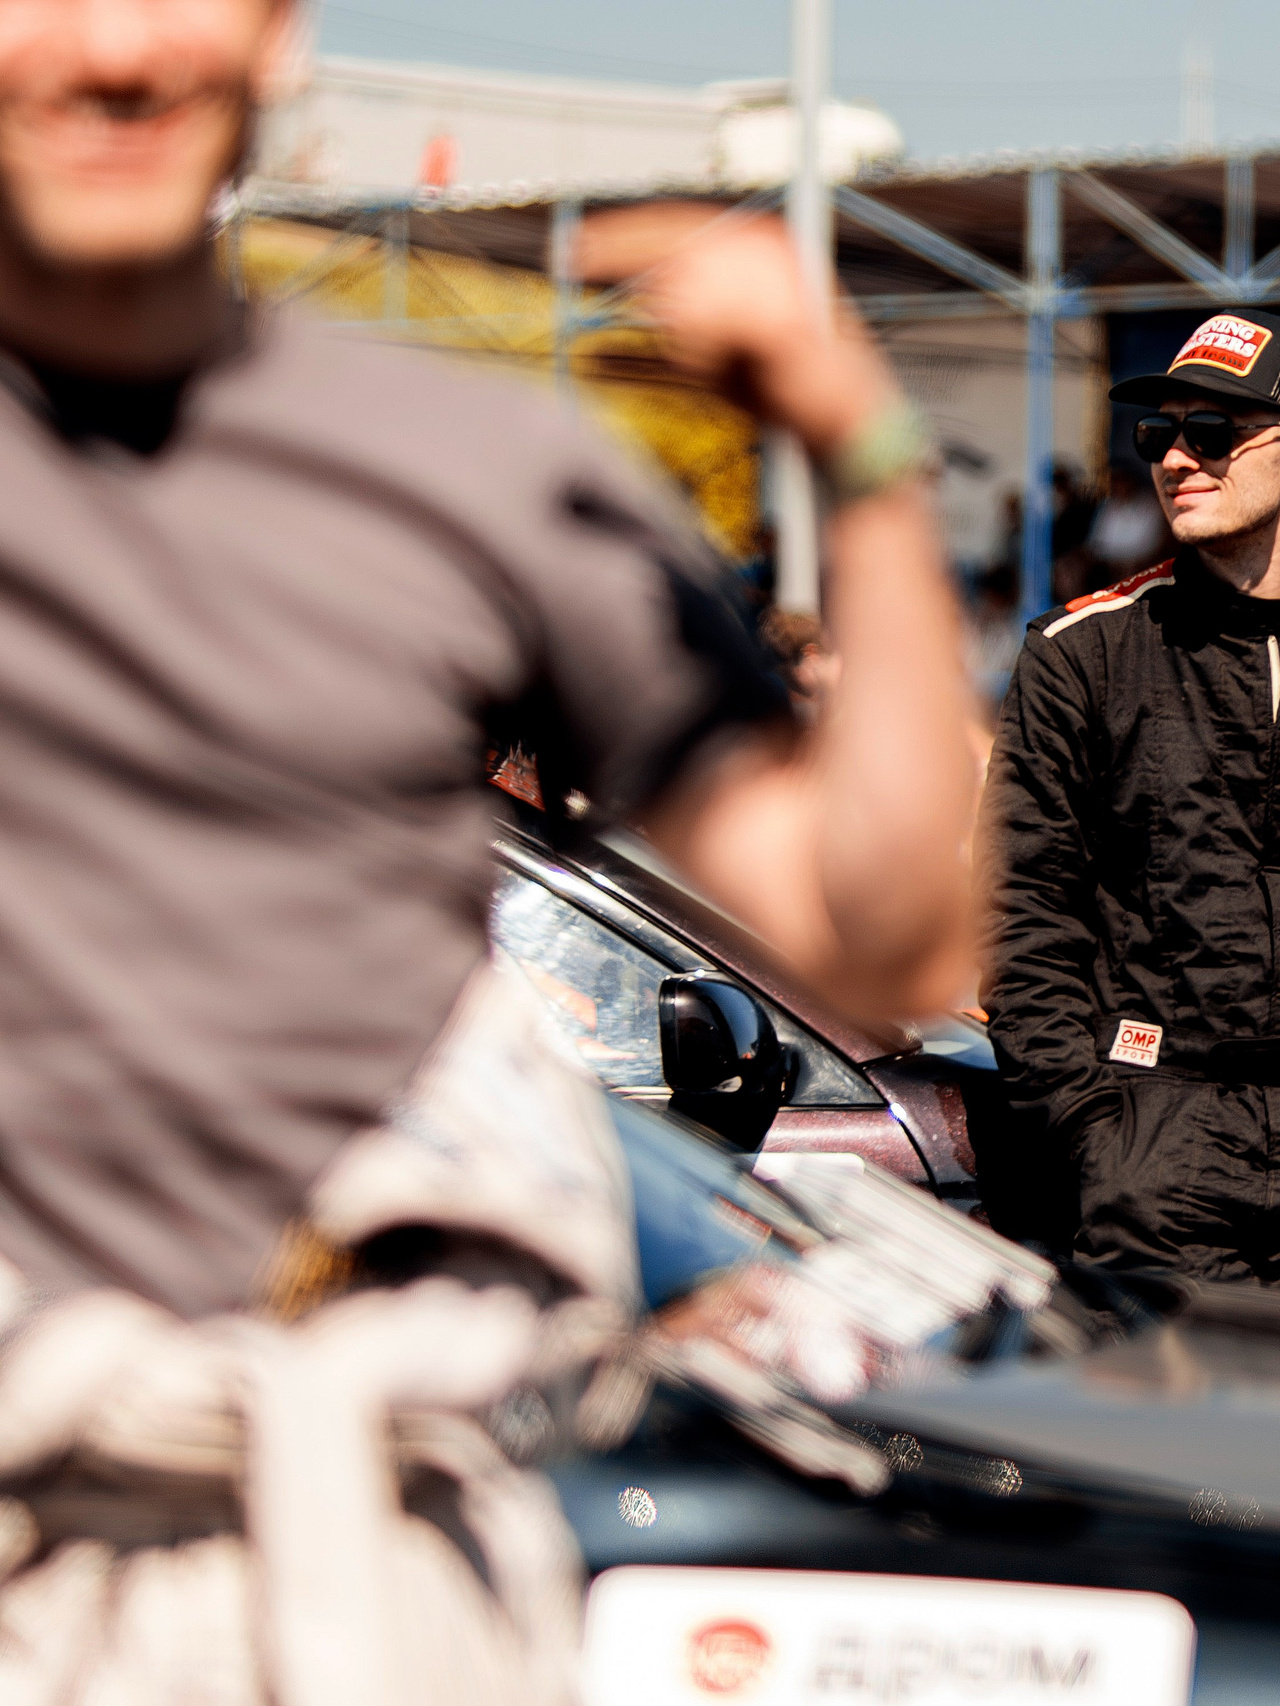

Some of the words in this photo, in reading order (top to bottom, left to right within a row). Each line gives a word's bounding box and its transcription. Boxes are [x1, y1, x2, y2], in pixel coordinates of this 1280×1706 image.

[1199, 320, 1256, 341] NING
[1179, 332, 1257, 358] STERS
[1121, 1030, 1156, 1048] OMP
[1115, 1048, 1153, 1061] SPORT
